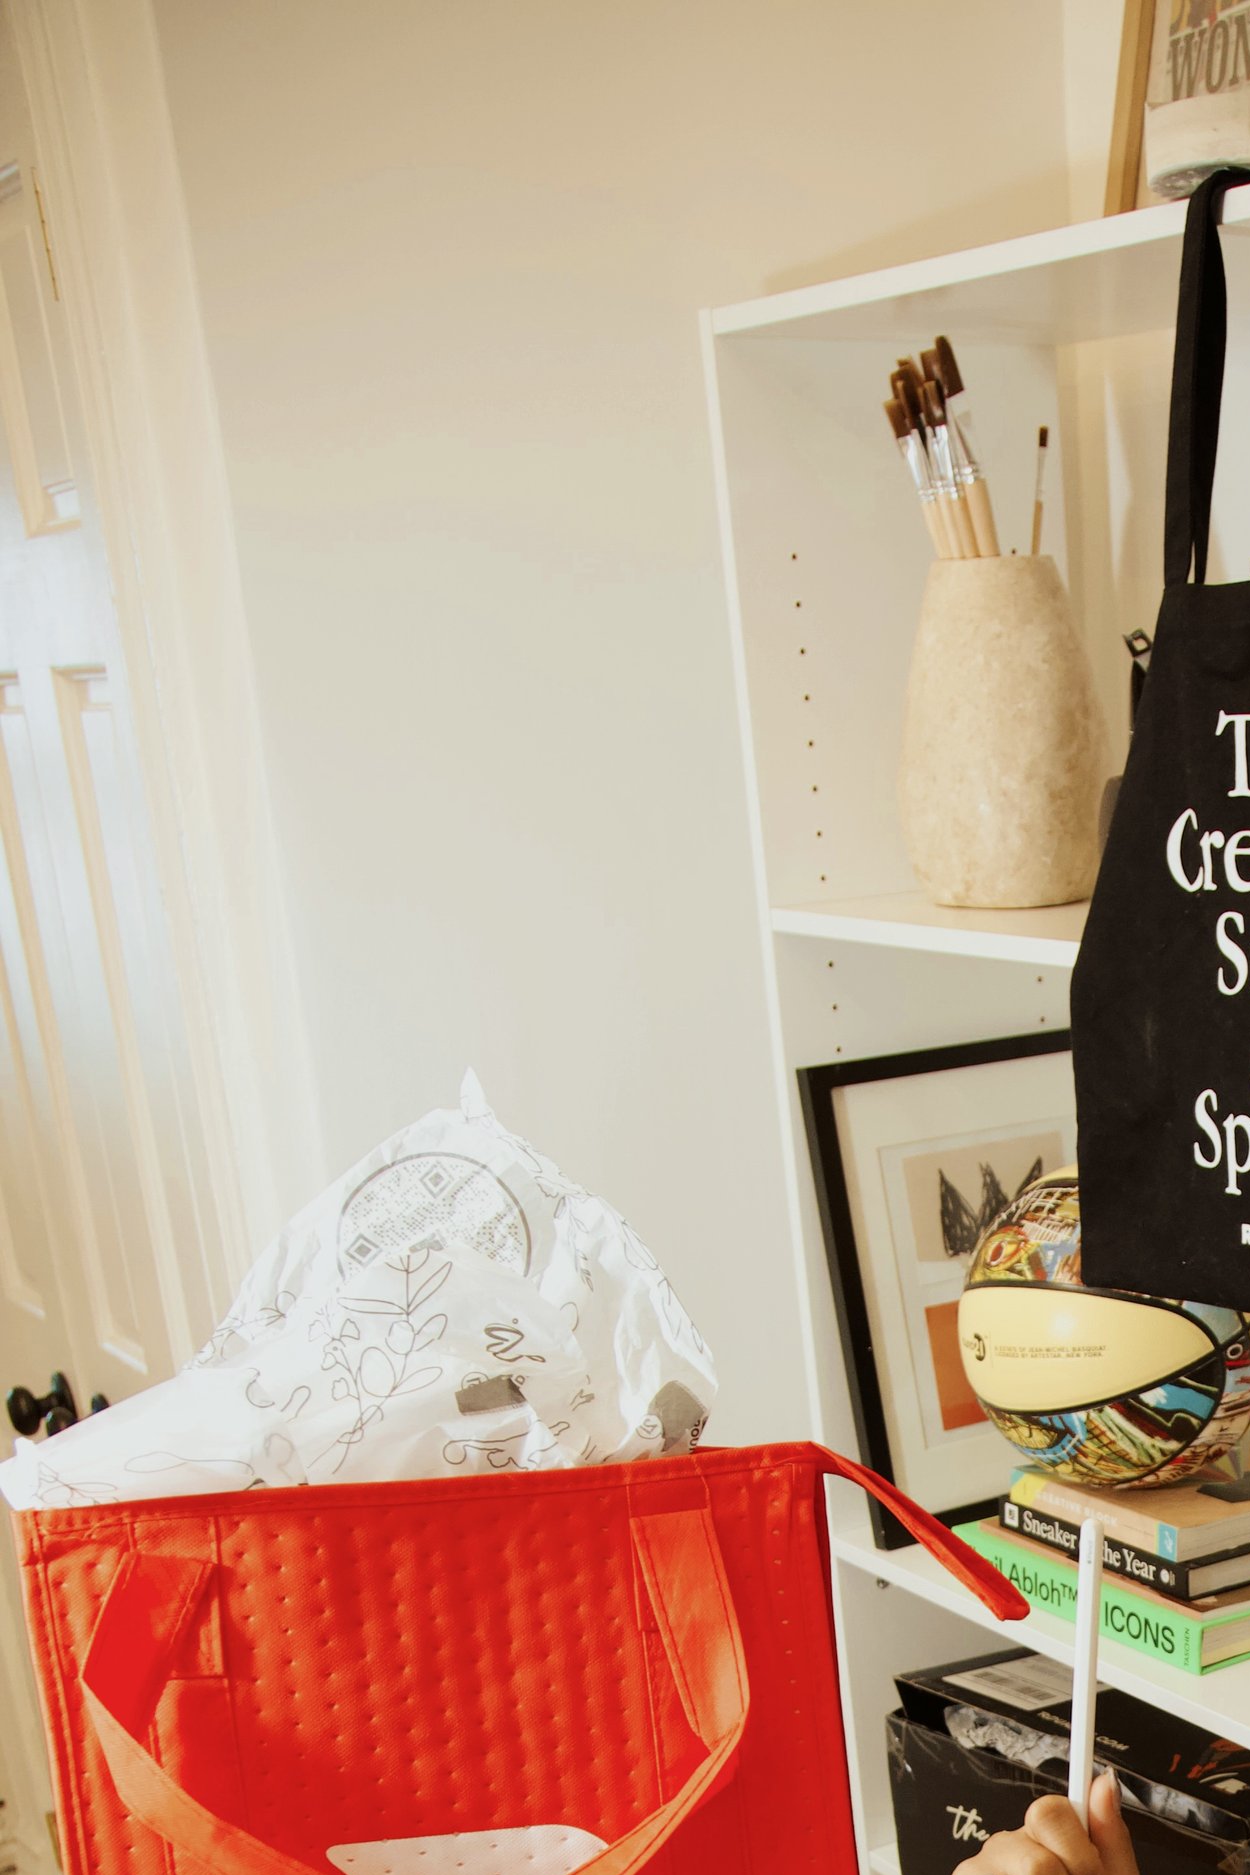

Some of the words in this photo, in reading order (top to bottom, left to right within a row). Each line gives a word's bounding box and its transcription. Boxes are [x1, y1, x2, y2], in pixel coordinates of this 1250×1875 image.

[1022, 1509, 1078, 1550] Sneaker
[1102, 1540, 1122, 1568] he
[1122, 1547, 1157, 1581] Year
[1104, 1601, 1176, 1655] ICONS
[1183, 1627, 1191, 1667] TASCHEN
